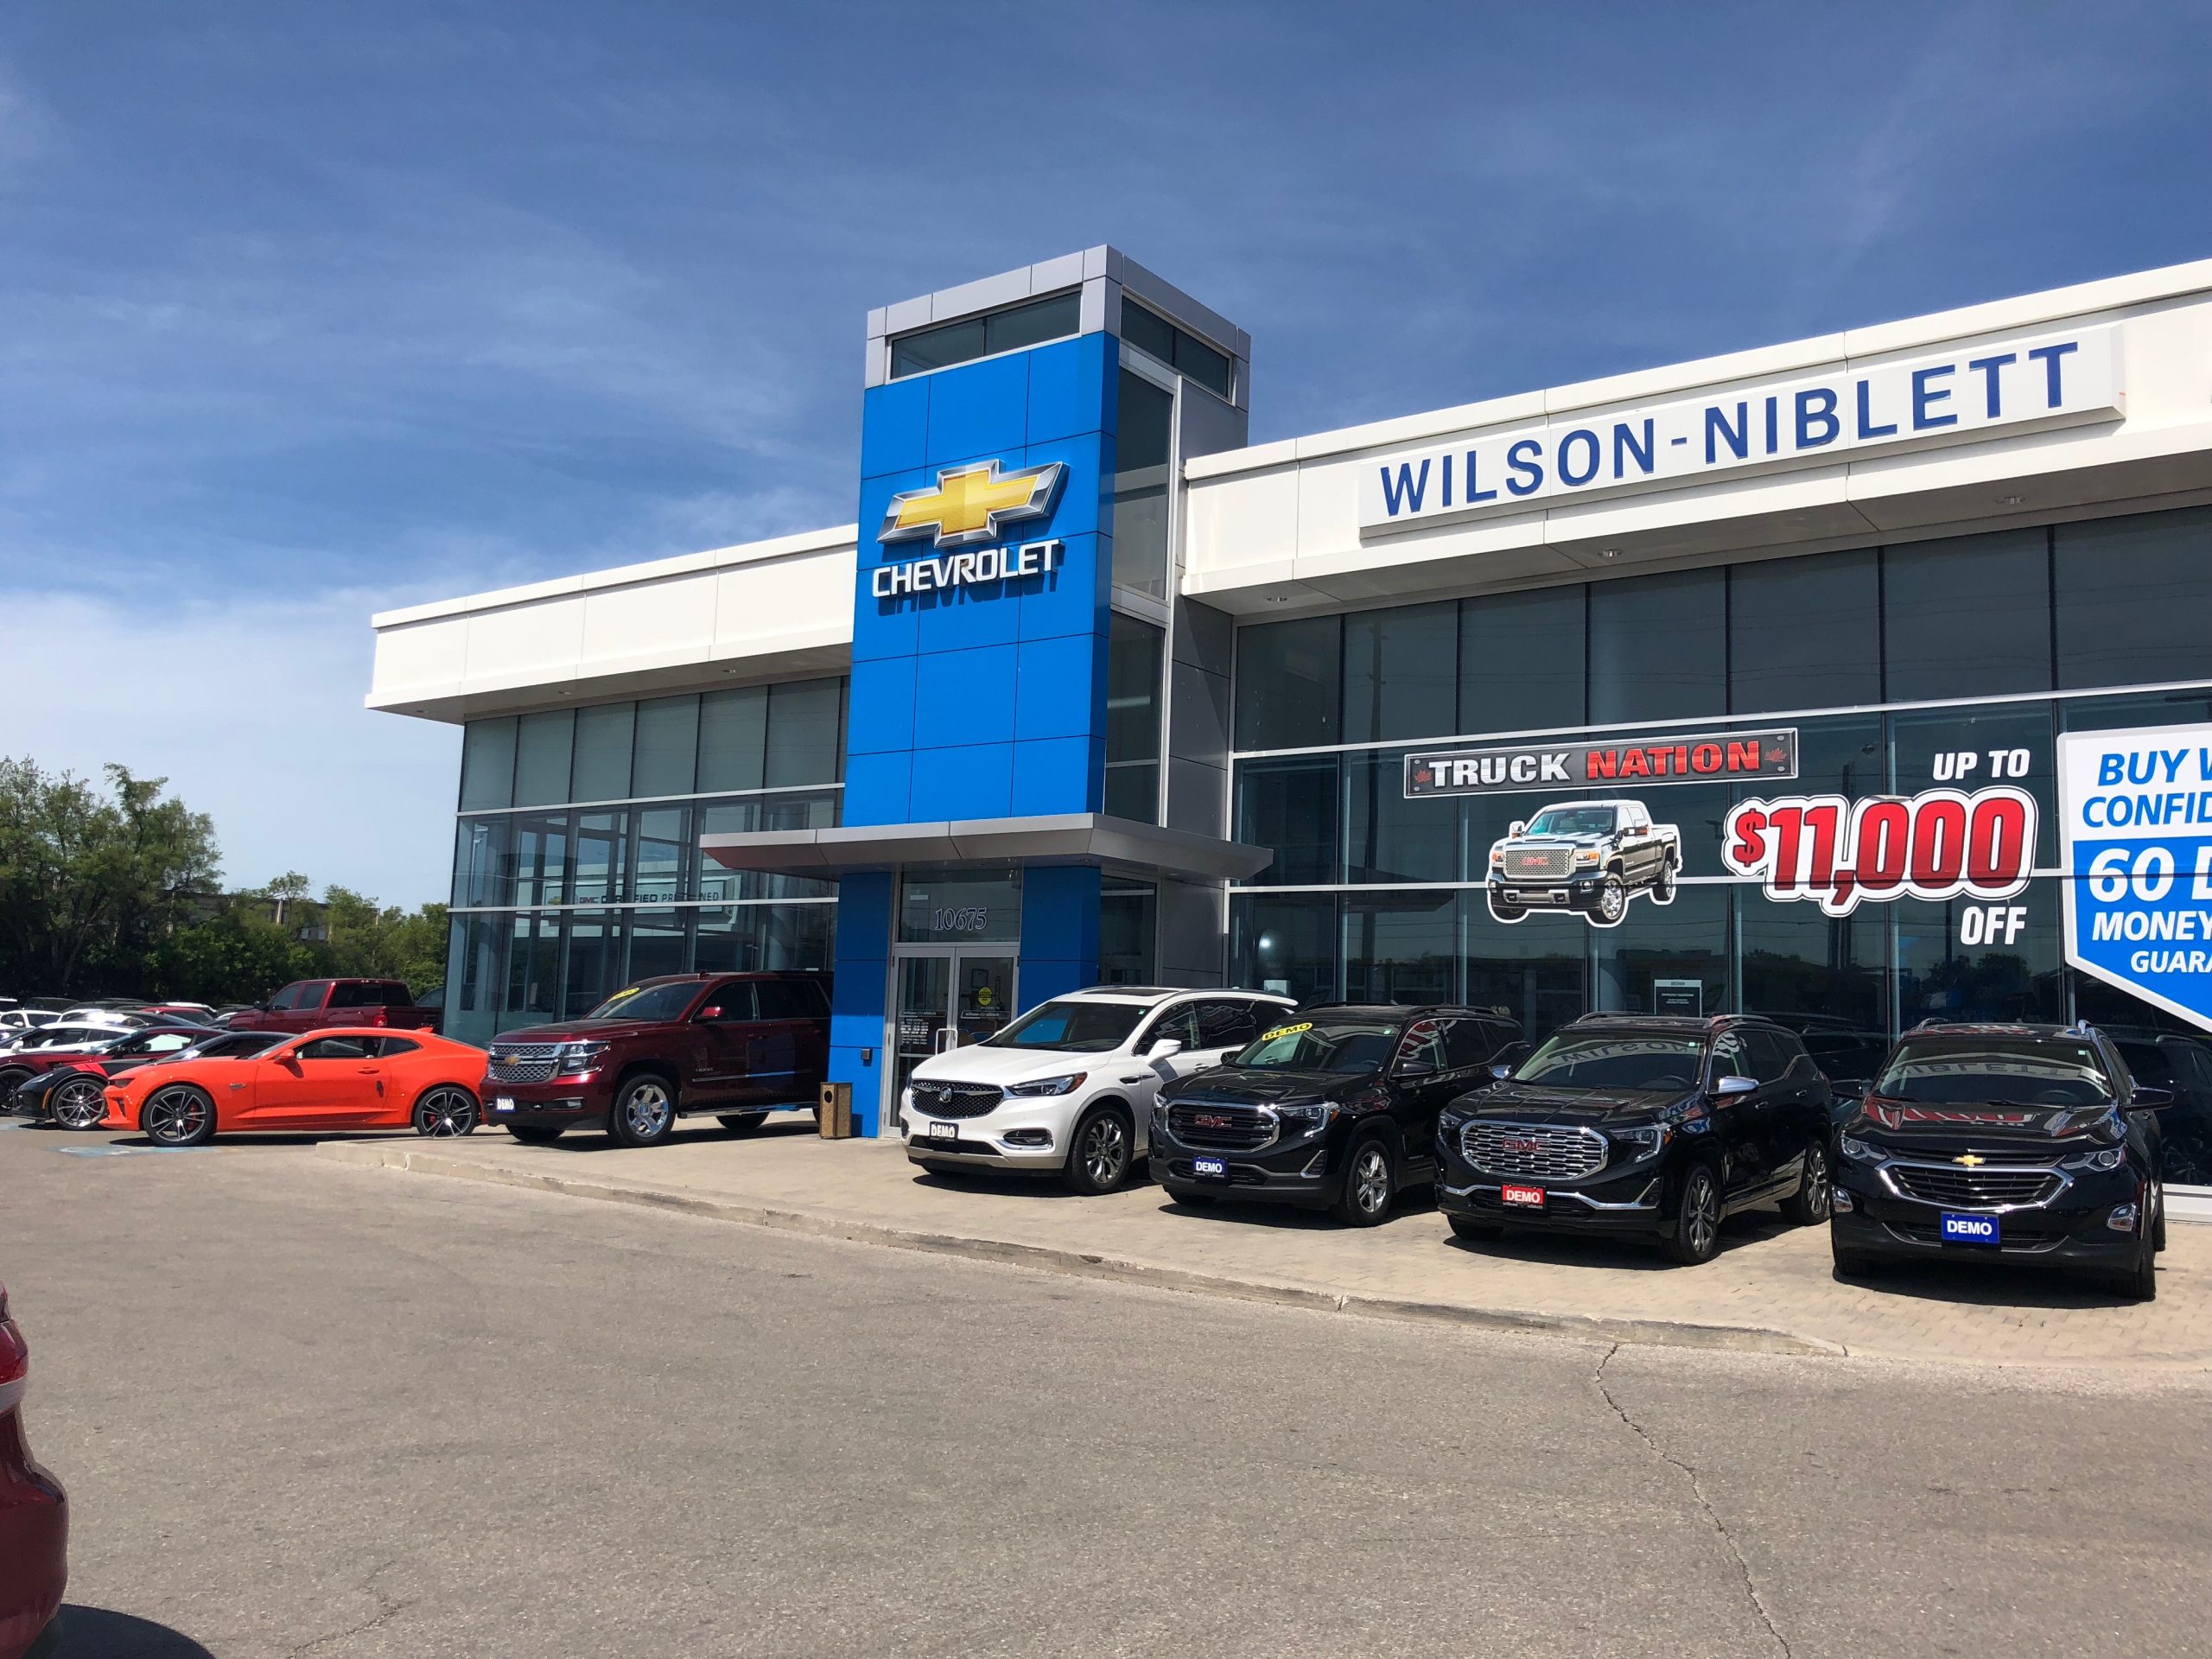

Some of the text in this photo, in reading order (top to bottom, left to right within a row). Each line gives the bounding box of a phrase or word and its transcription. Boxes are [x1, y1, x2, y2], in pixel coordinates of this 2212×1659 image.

[1379, 340, 2079, 517] WILSON-NIBLETT
[872, 539, 1059, 598] CHEVROLET
[1429, 741, 1760, 787] TRUCK NATION
[1933, 748, 2031, 781] UP TO
[2098, 748, 2190, 786] BUY
[1732, 797, 2025, 906] $11,000
[2088, 847, 2175, 902] 60
[601, 894, 658, 904] CRFIED
[934, 907, 988, 931] 10675
[1960, 906, 2027, 945] OFF
[1264, 1024, 1310, 1039] DEMO
[497, 1097, 515, 1110] DEMO
[931, 1123, 956, 1138] DEMO
[1194, 1114, 1232, 1128] GMC
[1503, 1137, 1550, 1154] GMC
[1195, 1161, 1224, 1173] DEMO
[1506, 1190, 1541, 1204] DEMO
[1947, 1220, 1993, 1236] DEMO
